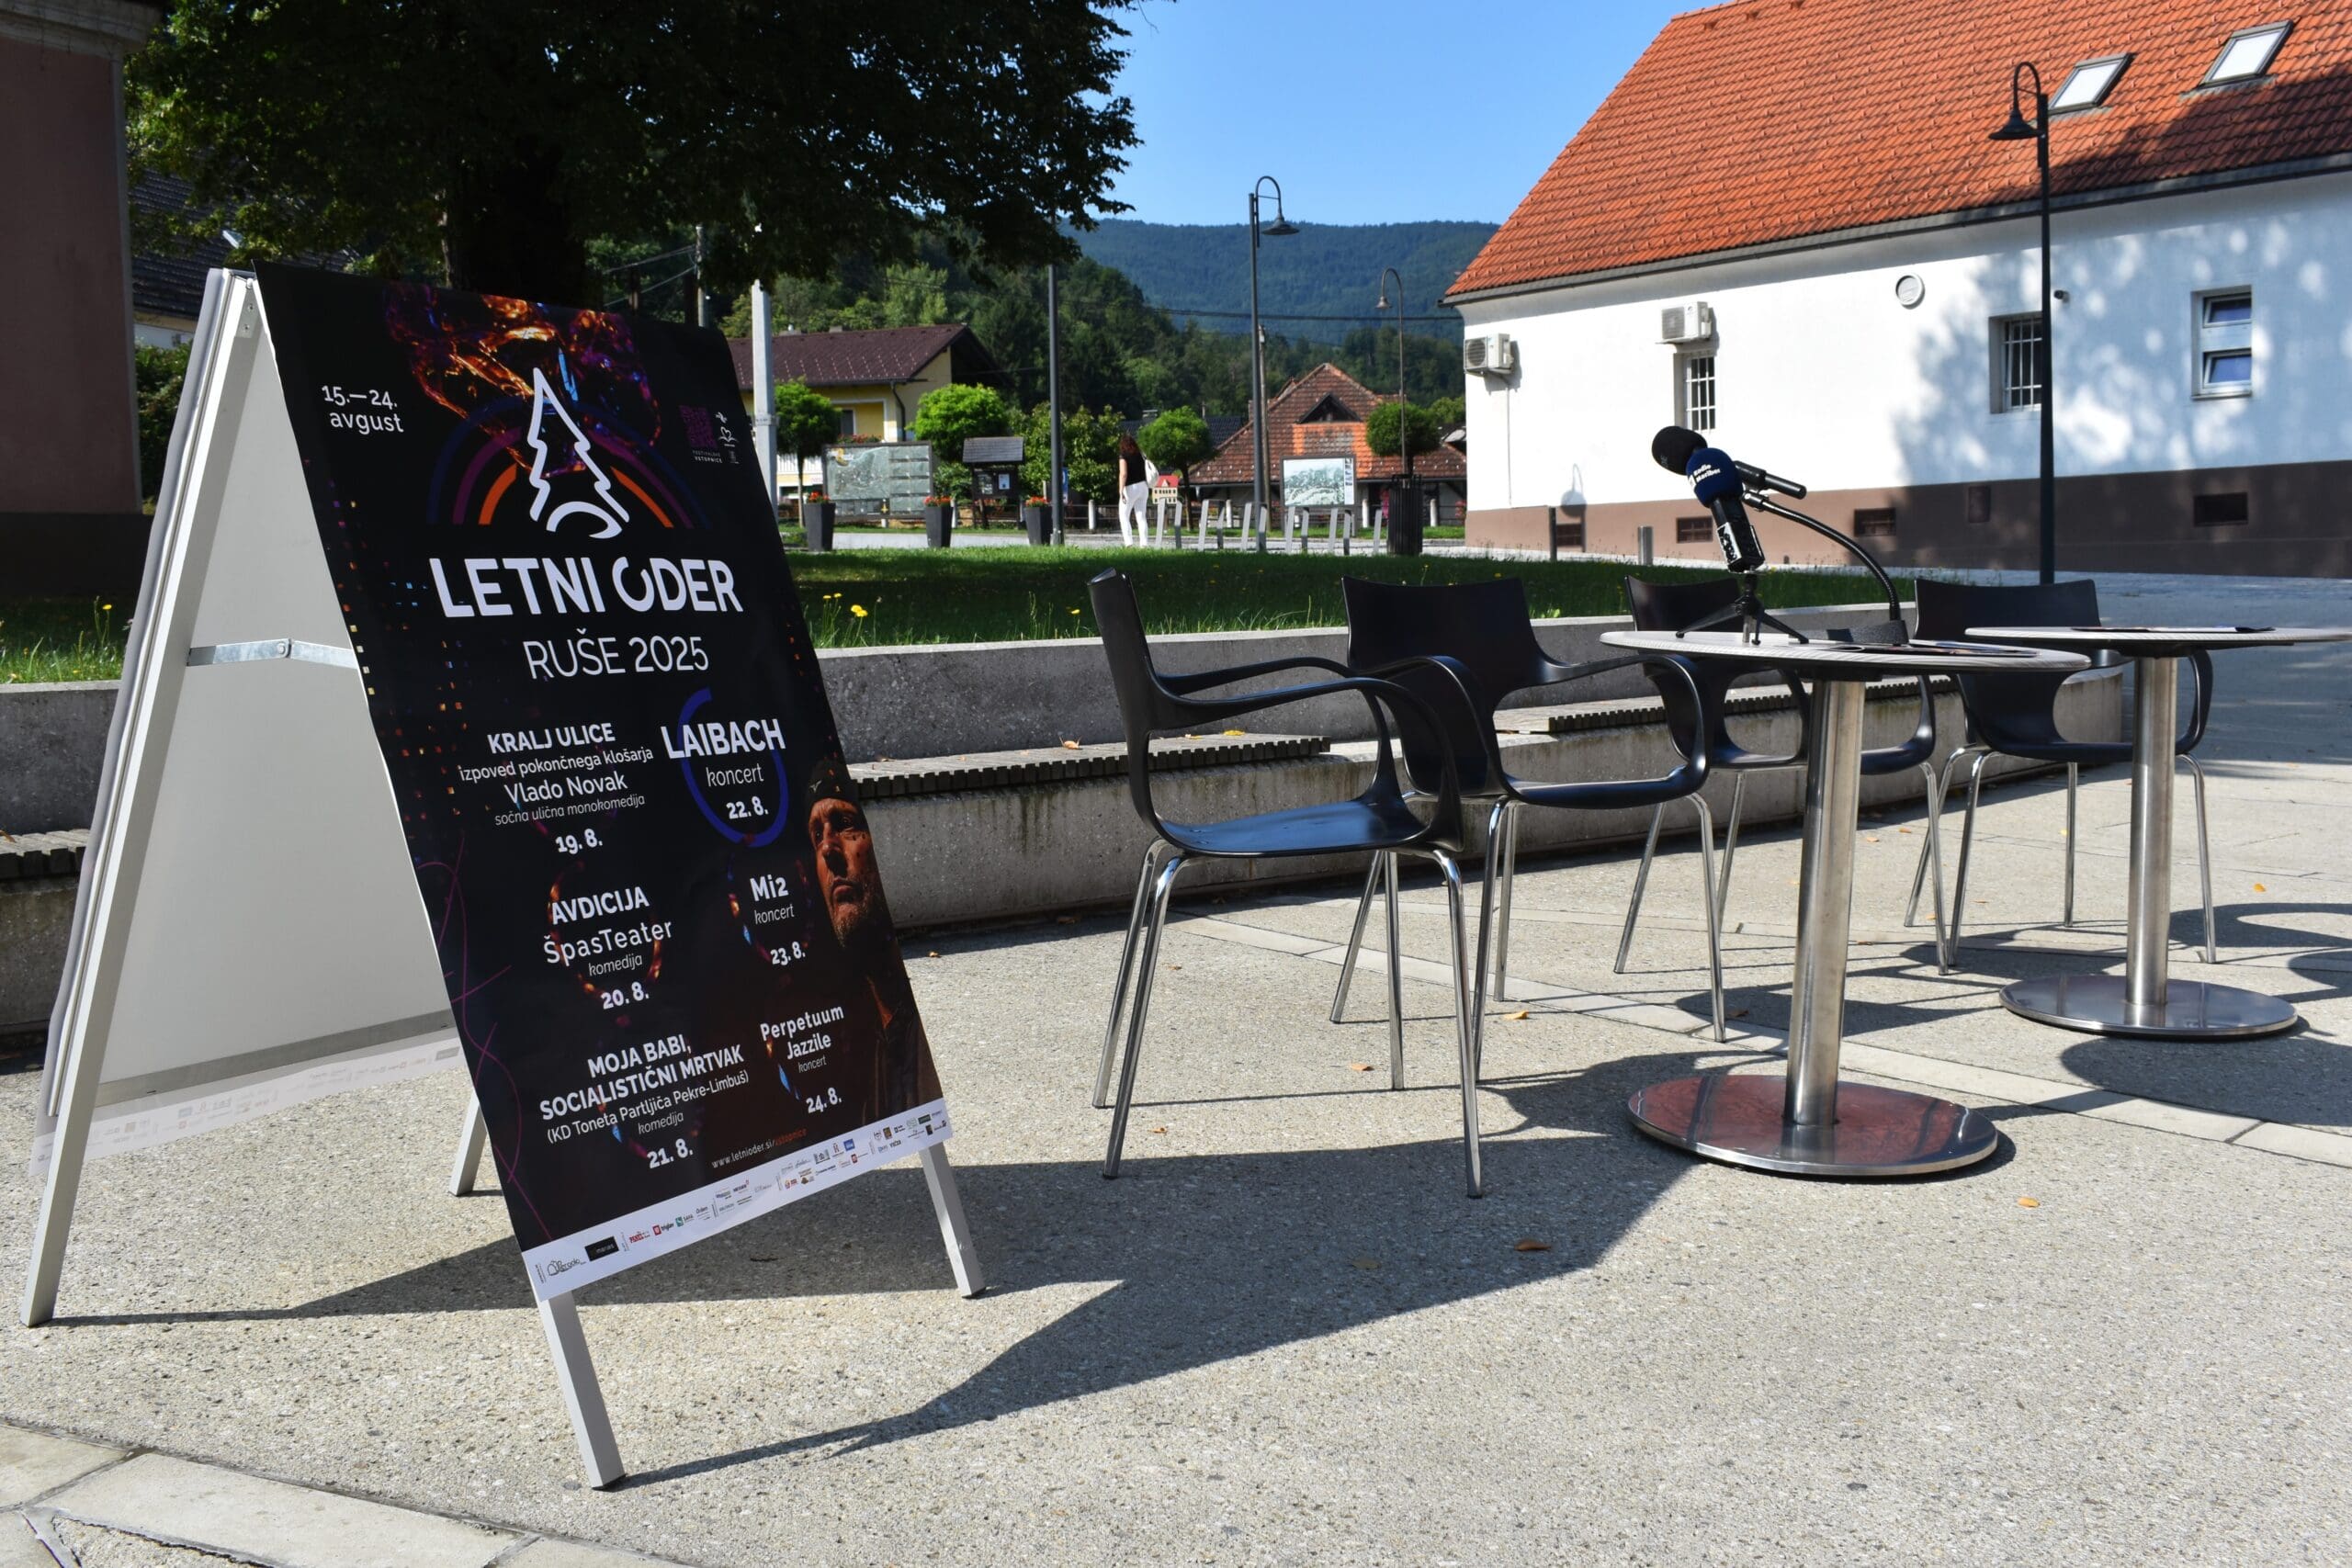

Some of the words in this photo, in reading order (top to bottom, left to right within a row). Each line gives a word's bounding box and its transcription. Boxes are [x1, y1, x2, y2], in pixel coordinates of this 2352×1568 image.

[329, 412, 404, 435] avgust
[428, 557, 606, 618] LETNI
[611, 556, 744, 613] ODER
[523, 627, 627, 680] RUŠE
[628, 635, 709, 672] 2025
[487, 728, 553, 754] KRALJ
[555, 722, 616, 747] ULICE
[660, 718, 786, 760] LAIBACH
[458, 761, 516, 784] izpoved
[518, 754, 603, 778] pokončnega
[602, 748, 654, 764] klošarja
[706, 762, 764, 787] koncert
[503, 779, 563, 804] Vlado
[566, 771, 628, 796] Novak
[494, 811, 529, 826] sočna
[531, 807, 565, 820] ulična
[567, 794, 646, 816] monokomedija
[726, 801, 752, 819] 22.
[751, 795, 769, 816] 8.
[555, 834, 583, 855] 19.
[583, 828, 604, 848] 8.
[749, 874, 789, 902] Mi2
[551, 886, 650, 925] AVDICIJA
[753, 903, 795, 925] koncert
[543, 921, 672, 967] ŠpasTeater
[770, 947, 792, 966] 23.
[791, 941, 806, 959] 8.
[588, 953, 643, 976] komedija
[600, 988, 630, 1010] 20.
[631, 981, 650, 1001] 8.
[760, 1006, 844, 1042] Perpetuum
[587, 1046, 643, 1078] MOJA
[642, 1033, 692, 1063] BABI,
[786, 1032, 831, 1060] Jazzile
[797, 1055, 827, 1074] koncert
[539, 1065, 678, 1121] SOCIALISTIČNI
[679, 1043, 744, 1079] MRTVAK
[547, 1124, 571, 1144] (KD
[571, 1112, 618, 1135] Toneta
[618, 1096, 673, 1122] Partljiča
[673, 1069, 749, 1105] Pekre-Limbuš)
[805, 1094, 828, 1113] 24.
[827, 1087, 842, 1105] 8.
[638, 1110, 684, 1134] komedija
[646, 1147, 674, 1169] 21.
[675, 1138, 694, 1158] 8.
